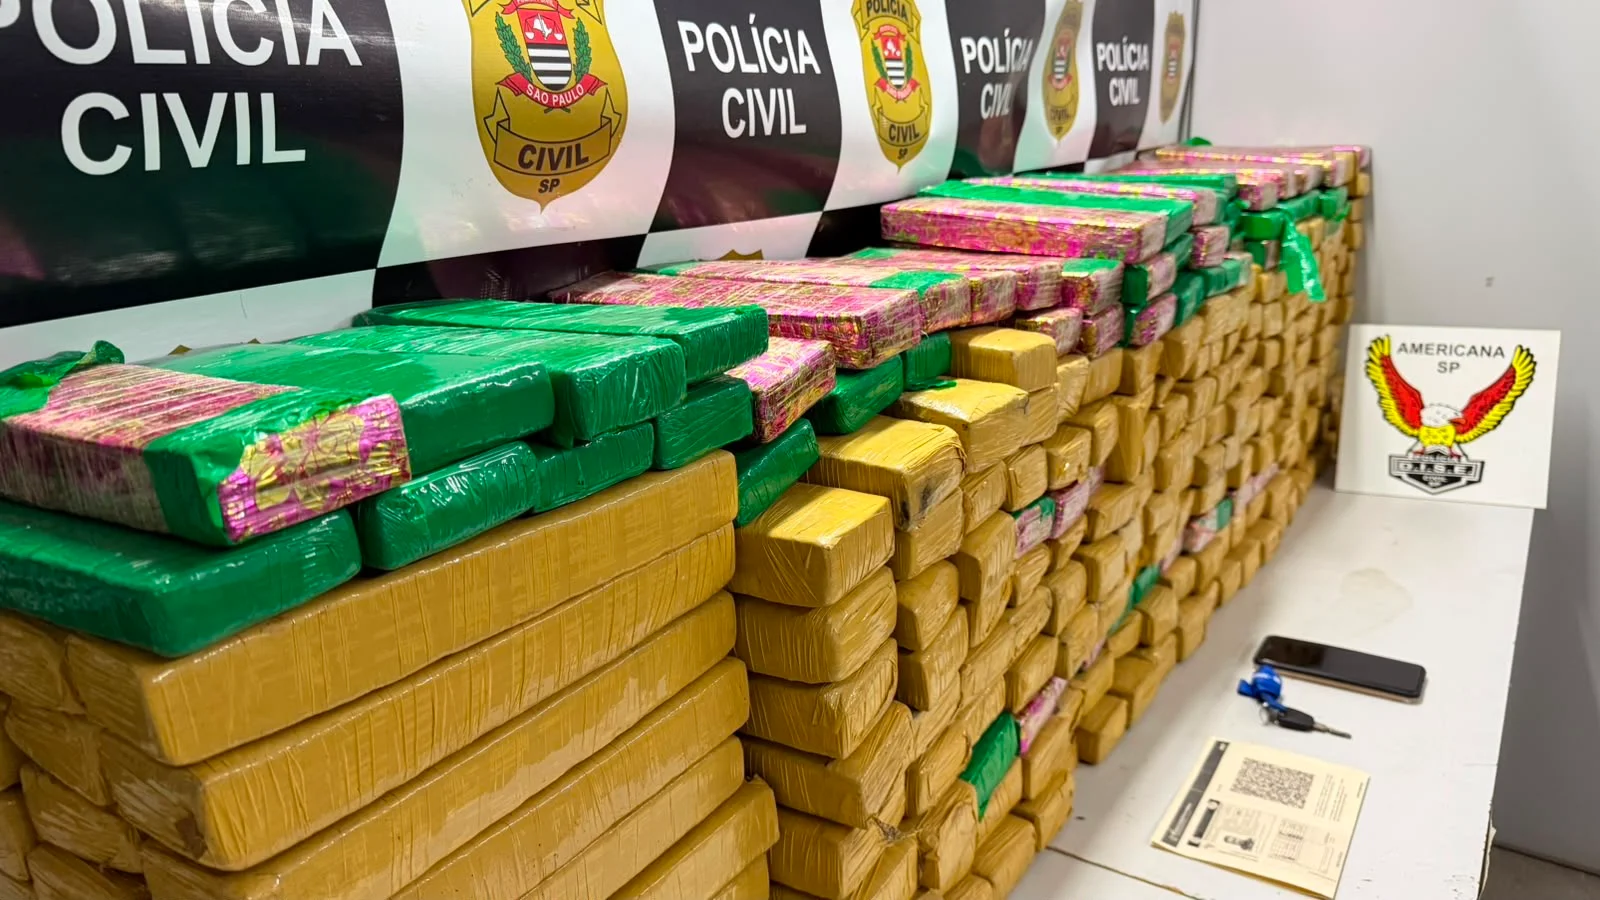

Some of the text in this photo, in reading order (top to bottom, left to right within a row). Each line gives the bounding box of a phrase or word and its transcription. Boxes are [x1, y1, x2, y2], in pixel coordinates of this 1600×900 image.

[677, 13, 821, 75] POLÍCIA
[960, 28, 1034, 74] POLÍCIA
[1096, 36, 1150, 72] POLÍCIA
[552, 83, 584, 106] PAULO
[980, 82, 1013, 120] CIVIL
[1109, 77, 1141, 106] CIVIL
[722, 87, 807, 139] CIVIL
[61, 92, 306, 176] CIVIL
[889, 123, 920, 142] CIVIL
[517, 143, 590, 171] CIVIL
[538, 178, 560, 194] SP
[1396, 342, 1506, 359] AMERICANA
[1437, 361, 1460, 374] SP
